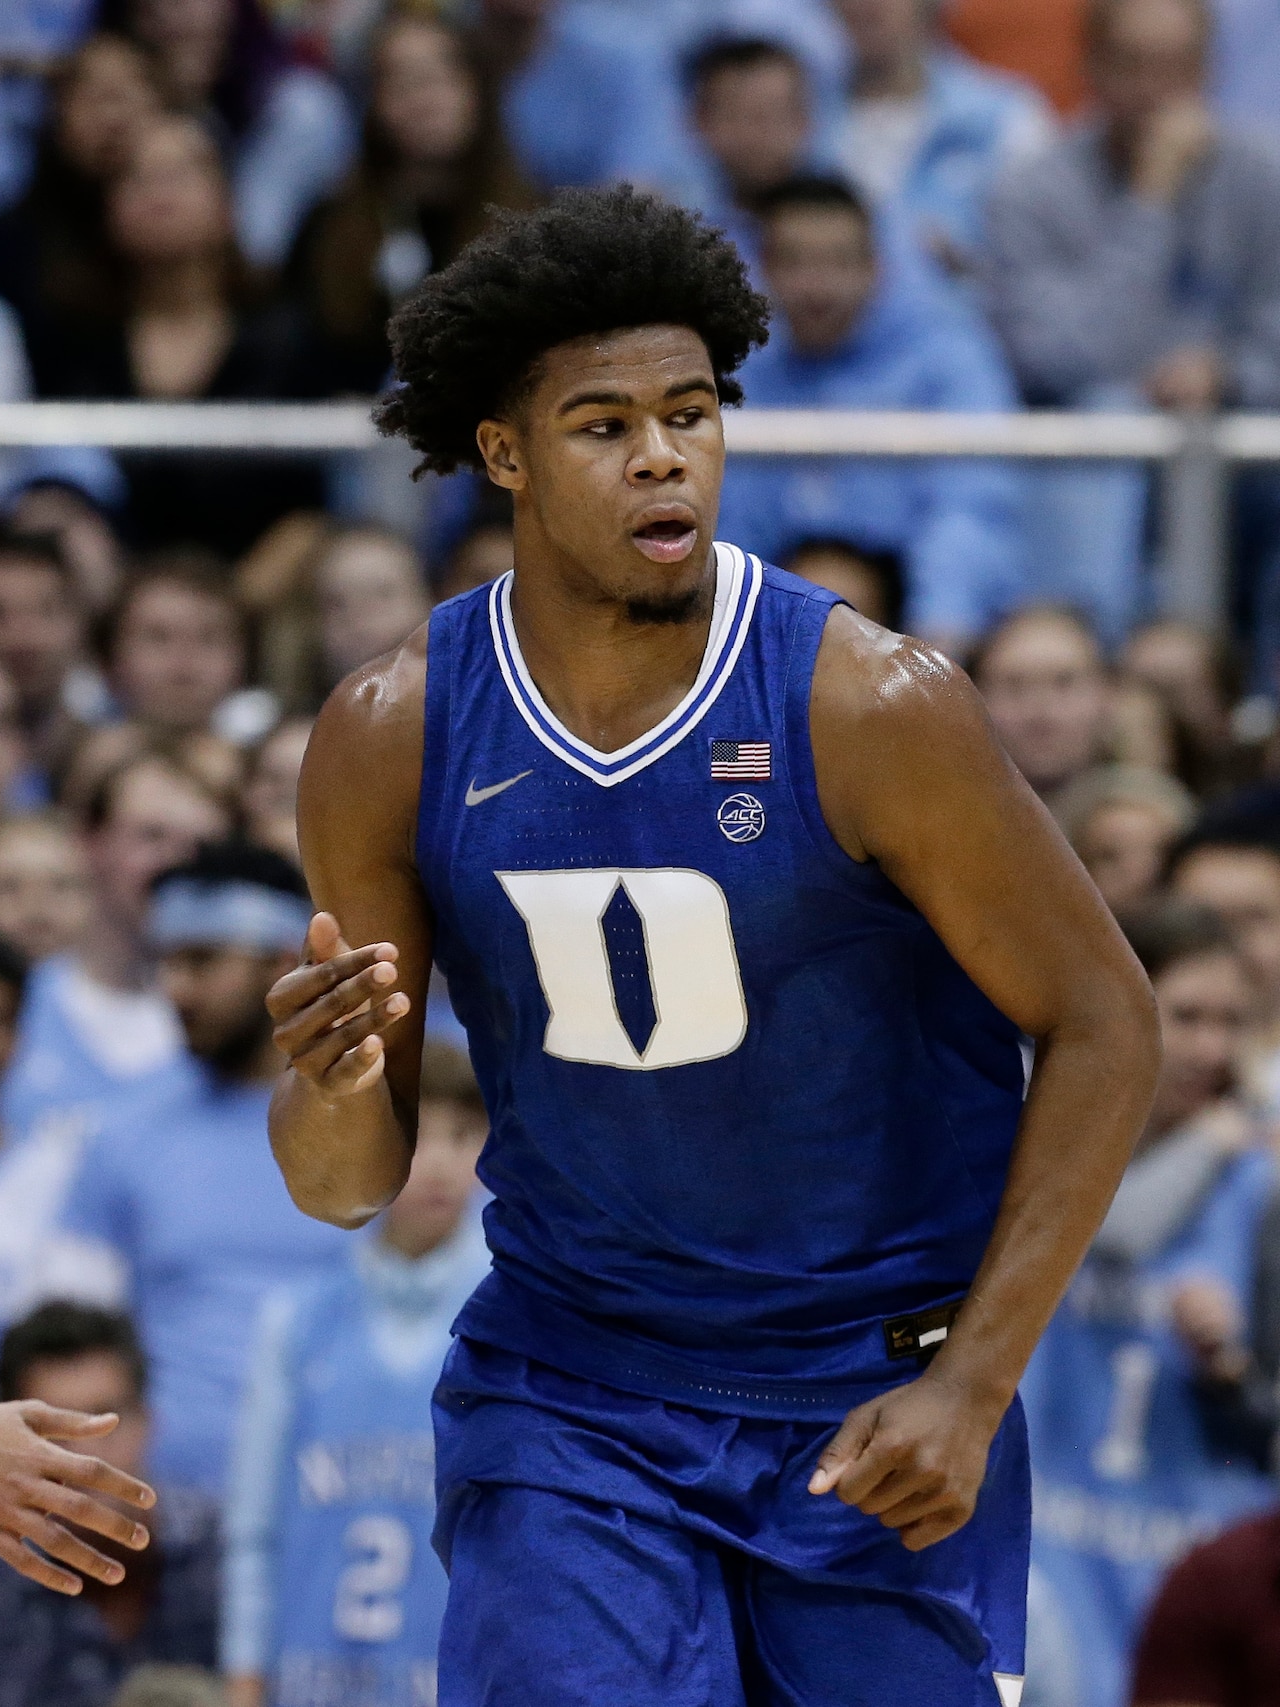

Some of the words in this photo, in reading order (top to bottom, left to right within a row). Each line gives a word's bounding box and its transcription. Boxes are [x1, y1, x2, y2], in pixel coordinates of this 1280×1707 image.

[723, 809, 763, 820] ACC
[493, 866, 748, 1071] D
[332, 1513, 414, 1642] 2
